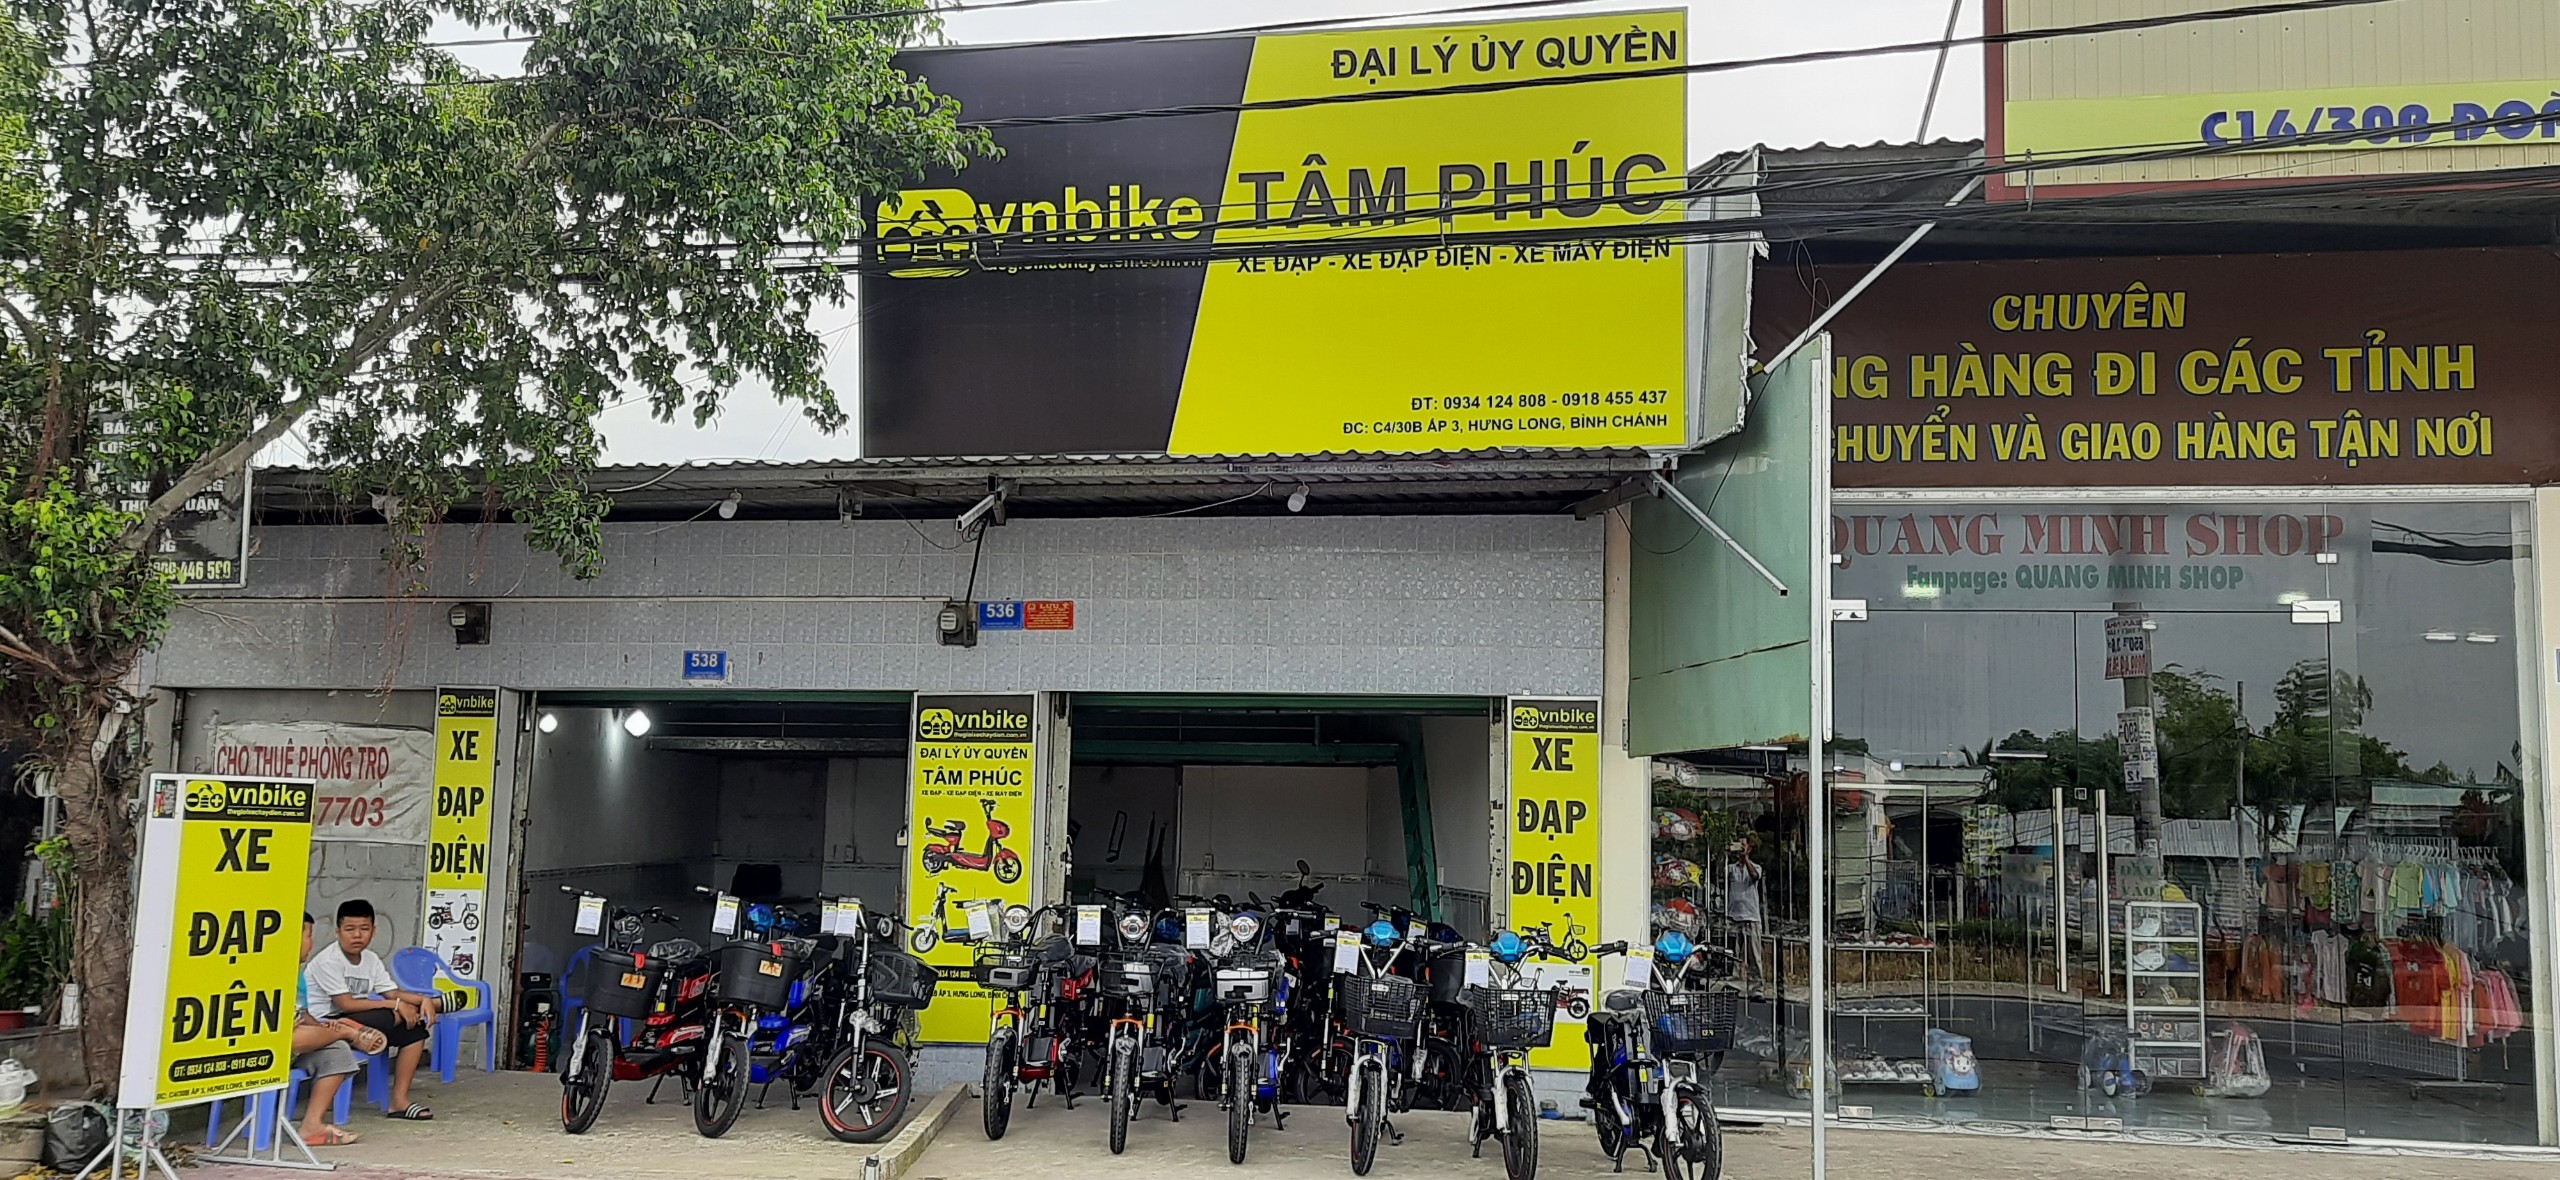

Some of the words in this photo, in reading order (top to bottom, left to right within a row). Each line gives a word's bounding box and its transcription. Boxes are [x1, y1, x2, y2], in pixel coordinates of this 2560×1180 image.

[1331, 47, 1396, 85] ĐẠI
[1411, 36, 1458, 75] LÝ
[1472, 34, 1524, 71] ỦY
[1536, 25, 1677, 69] QUYỀN
[2201, 104, 2430, 147] C16/30B
[1238, 153, 1406, 230] TÂM
[1439, 141, 1667, 222] PHÚC
[979, 184, 1203, 243] vnbike
[1237, 256, 1267, 273] XE
[1273, 255, 1322, 276] ĐẠP
[1342, 252, 1373, 271] XE
[1379, 249, 1428, 273] ĐẠP
[1513, 245, 1545, 264] XE
[1990, 281, 2187, 331] CHUYÊN
[1909, 342, 2073, 398] HÀNG
[2091, 350, 2157, 396] ĐI
[2177, 337, 2303, 395] CÁC
[2321, 329, 2475, 393] TỈNH
[1411, 396, 1438, 411] ĐT:
[1444, 395, 1480, 410] 0934
[1486, 394, 1513, 409] 124
[1518, 393, 1546, 408] 808
[1562, 392, 1600, 407] 0918
[1605, 391, 1634, 405] 455
[1638, 389, 1667, 404] 437
[1343, 422, 1368, 434] ĐC:
[1373, 421, 1422, 433] C4/30B
[1452, 420, 1463, 433] 3,
[1468, 418, 1513, 432] HƯNG
[1518, 417, 1565, 431] LONG,
[1570, 413, 1607, 429] BÌNH
[1612, 412, 1667, 428] CHÁNH
[1832, 404, 1977, 463] HUYỂN
[1989, 413, 2047, 461] VÀ
[2058, 422, 2162, 461] GIAO
[2174, 411, 2297, 460] HÀNG
[2307, 409, 2399, 467] TẬN
[2414, 411, 2493, 457] NƠI
[2020, 513, 2170, 556] MINH
[2185, 512, 2344, 559] SHOP
[1907, 565, 2008, 595] Fanpage:
[2015, 564, 2100, 591] QUANG
[2106, 564, 2172, 590] MINH
[2179, 565, 2245, 590] SHOP
[986, 603, 1015, 618] 536
[691, 653, 718, 667] 538
[456, 695, 494, 708] vnbike
[954, 709, 1028, 729] vnbike
[1539, 708, 1595, 723] vnbike
[217, 746, 250, 775] CHO
[253, 738, 295, 777] THUÊ
[300, 738, 353, 779] PHÒNG
[358, 746, 389, 788] TRỌ
[450, 730, 480, 761] XE
[920, 748, 941, 760] ĐẠI
[945, 745, 960, 758] LÝ
[1531, 737, 1573, 771] XE
[228, 783, 307, 806] vnbike
[922, 766, 962, 785] TÂM
[970, 766, 1022, 785] PHÚC
[317, 796, 385, 826] 7703
[437, 786, 485, 824] ĐẠP
[1517, 799, 1586, 841] ĐẠP
[215, 828, 273, 872] XE
[430, 834, 485, 880] ĐIỆN
[1511, 853, 1592, 904] ĐIỆN
[188, 910, 282, 965] ĐẠP
[172, 980, 282, 1047] ĐIỆN
